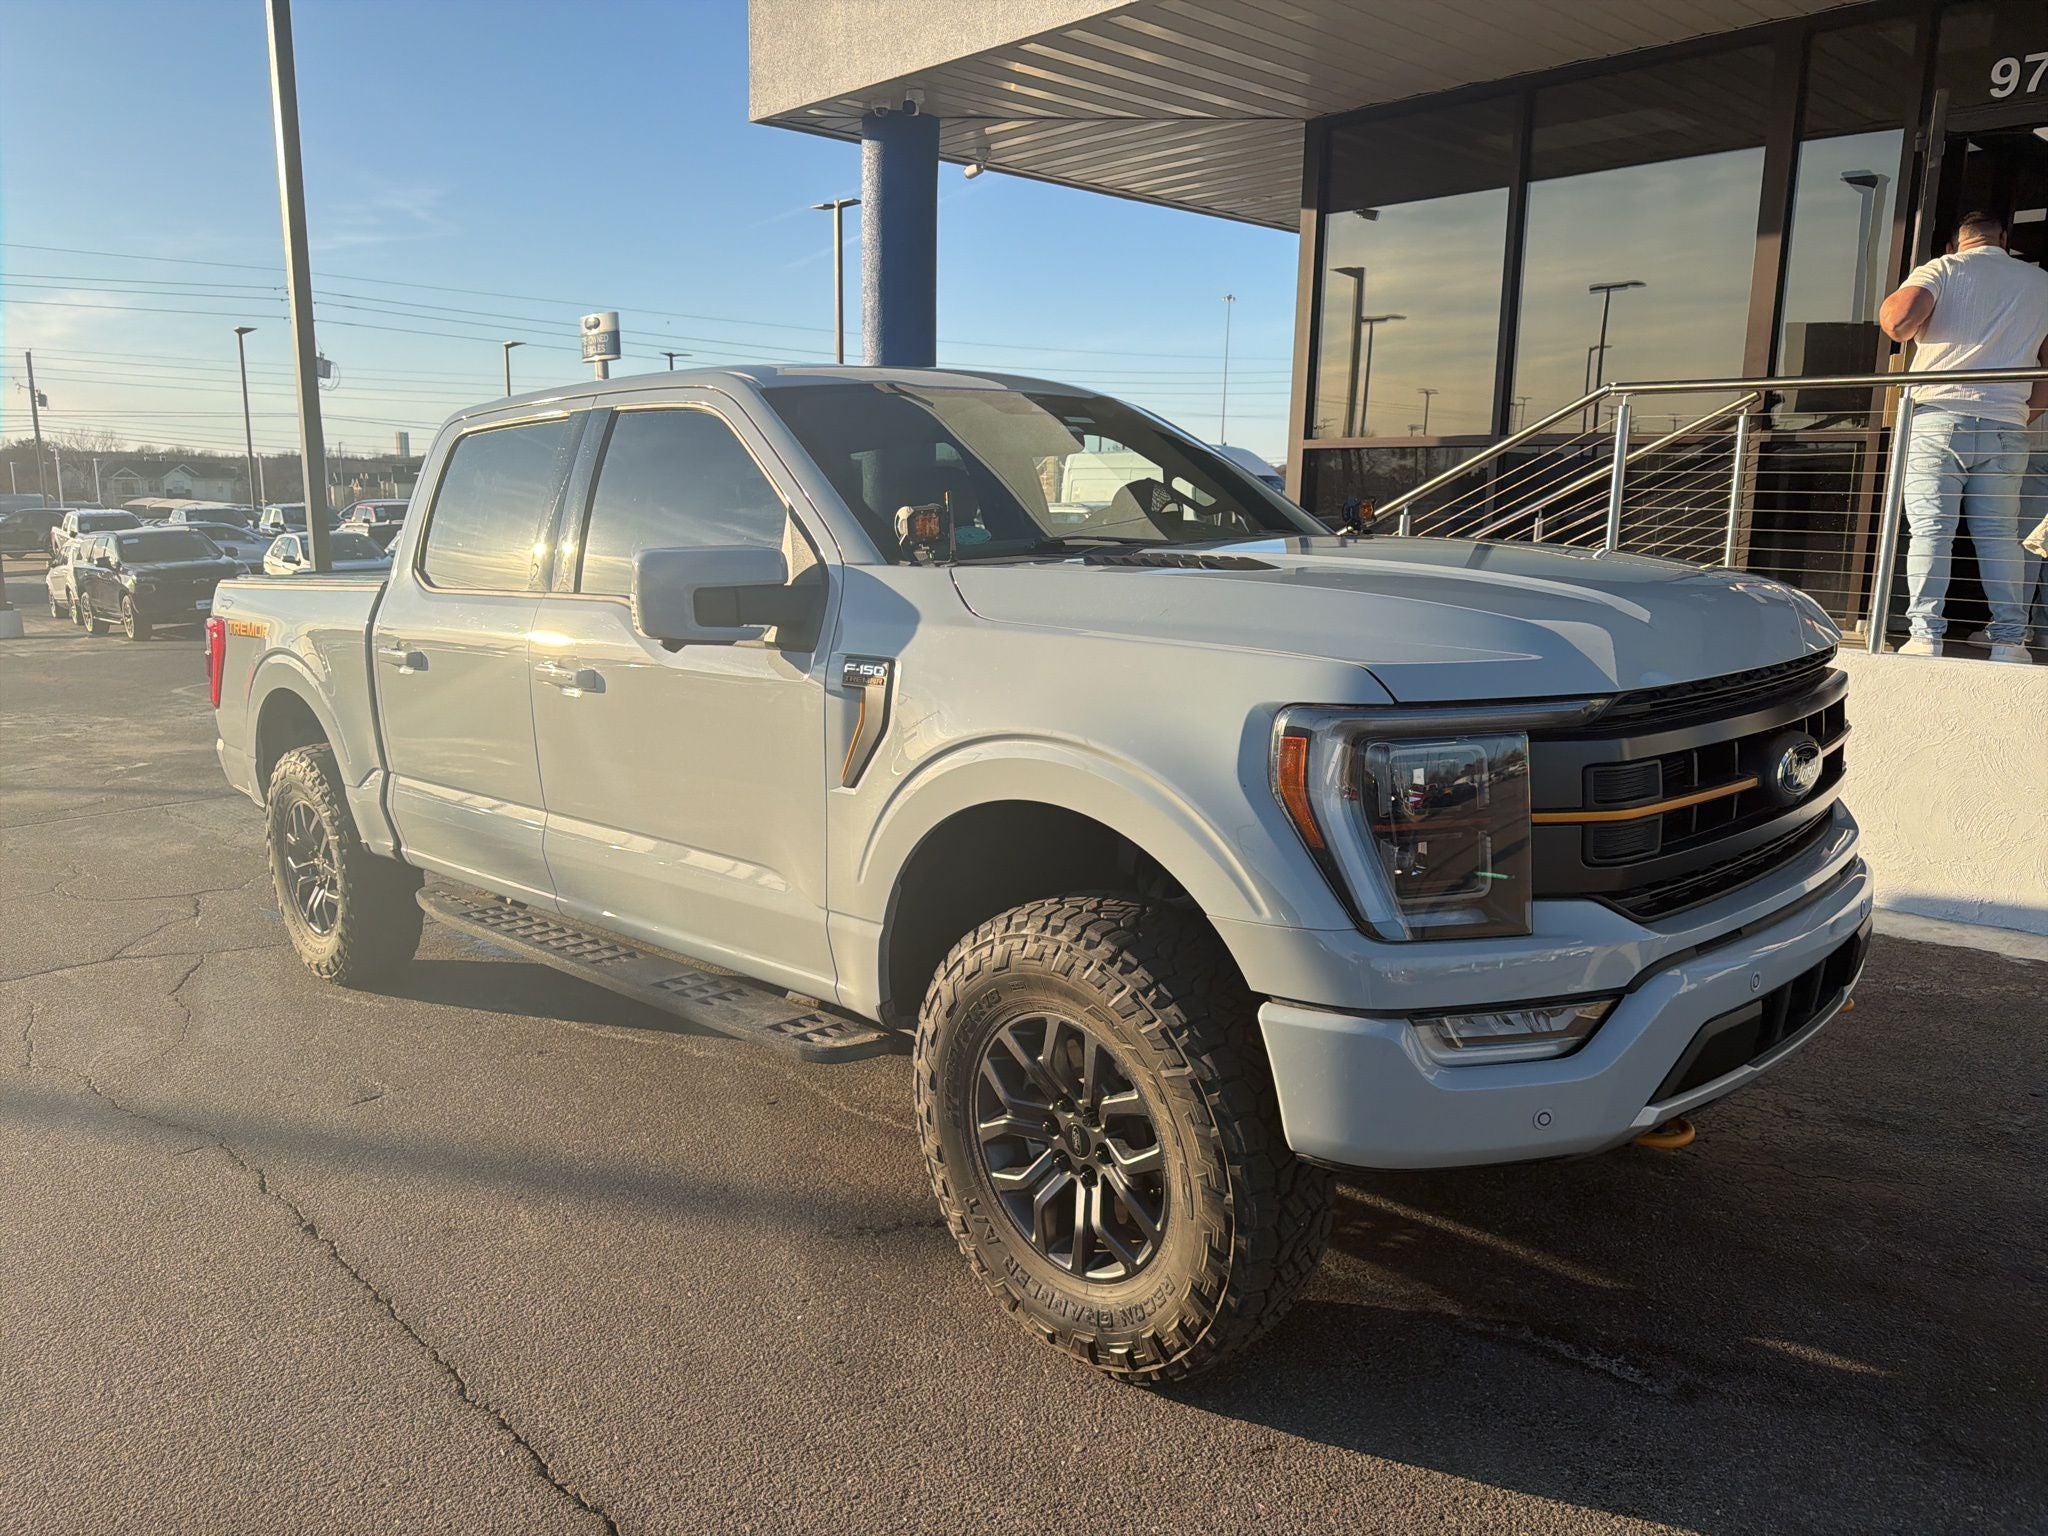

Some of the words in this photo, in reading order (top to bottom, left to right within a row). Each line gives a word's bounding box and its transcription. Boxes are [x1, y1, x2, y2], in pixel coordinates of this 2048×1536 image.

[1990, 52, 2048, 98] 97
[843, 663, 885, 676] F-150
[1120, 1272, 1176, 1328] RECON
